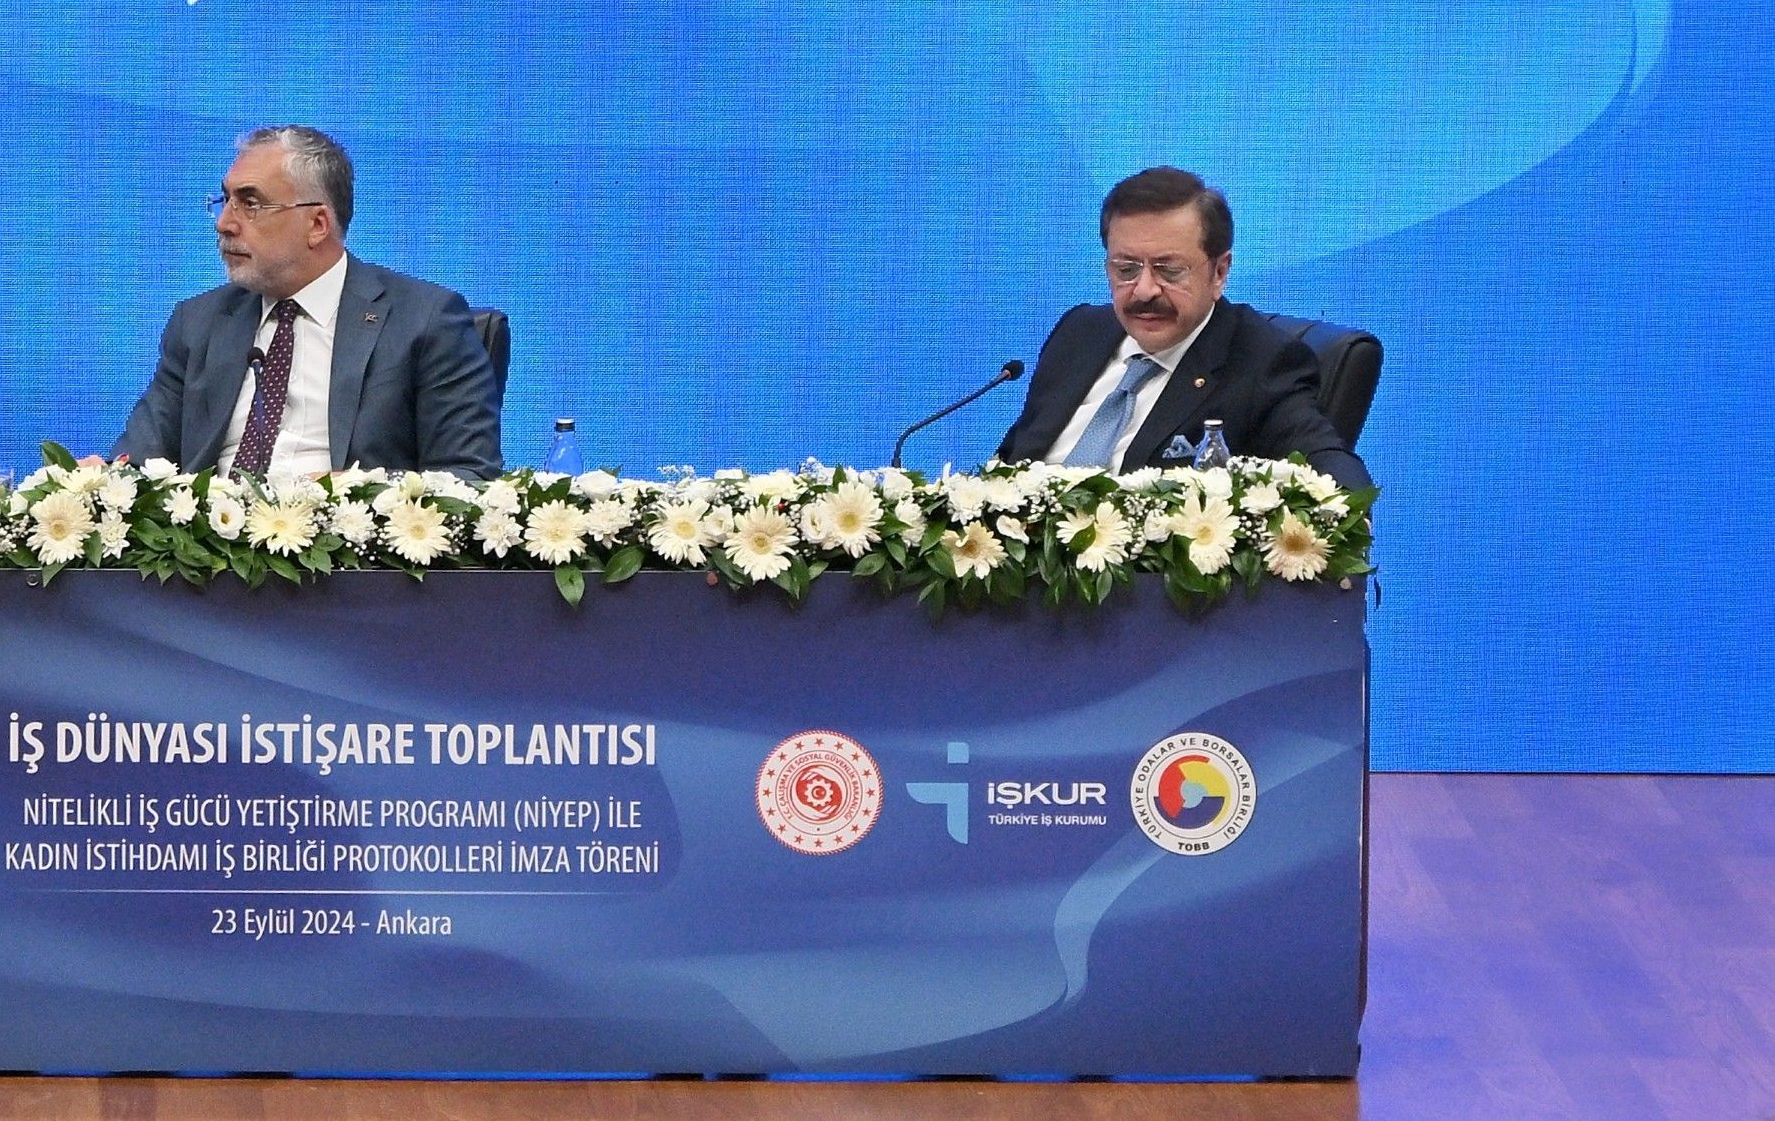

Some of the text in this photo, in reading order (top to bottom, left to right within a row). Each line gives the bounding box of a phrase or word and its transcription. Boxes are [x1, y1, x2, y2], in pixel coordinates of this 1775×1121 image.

[8, 712, 656, 776] İŞ DÜNYASI İSTİŞARE TOPLANTISI
[1138, 742, 1176, 781] ODALAR
[1180, 738, 1196, 746] VE
[1202, 739, 1250, 789] BORSALAR
[23, 793, 642, 834] NİTELİKLİ İŞ GÜCÜ YETİŞTİRME PROGRAMI (NİYEP) İLE
[988, 813, 1107, 826] TÜRKİYE İŞ KURUMU
[5, 838, 659, 878] KADIN İSTİHDAMI İŞ BİRLİĞİ PROTOKOLLERİ İMZA TÖRENİ
[1177, 842, 1210, 851] TOBB
[211, 909, 237, 934] 23
[244, 908, 294, 940] Eylül
[301, 909, 355, 935] 2024
[376, 909, 452, 935] Ankara
